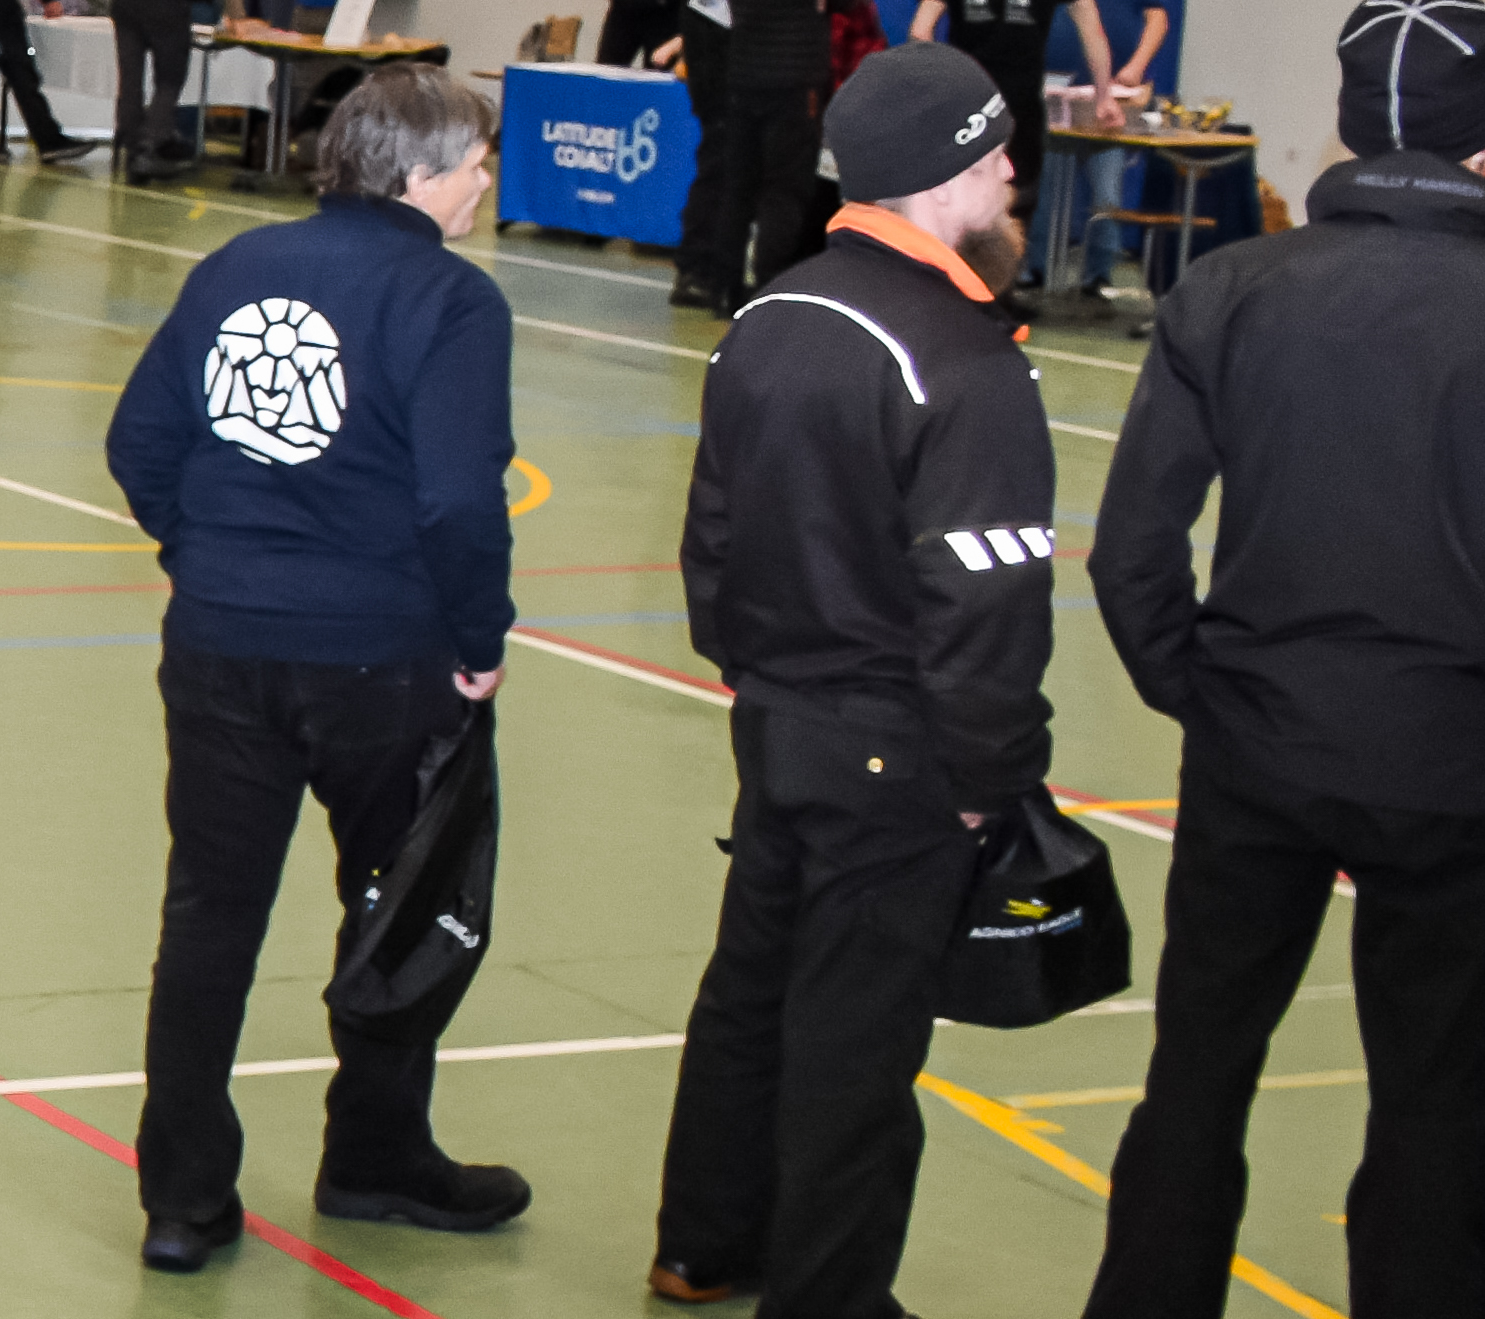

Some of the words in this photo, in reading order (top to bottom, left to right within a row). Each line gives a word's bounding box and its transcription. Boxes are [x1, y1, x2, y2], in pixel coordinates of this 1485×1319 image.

[542, 120, 617, 150] LATITUDE
[554, 144, 616, 174] COBALT
[1354, 173, 1407, 189] HELLY
